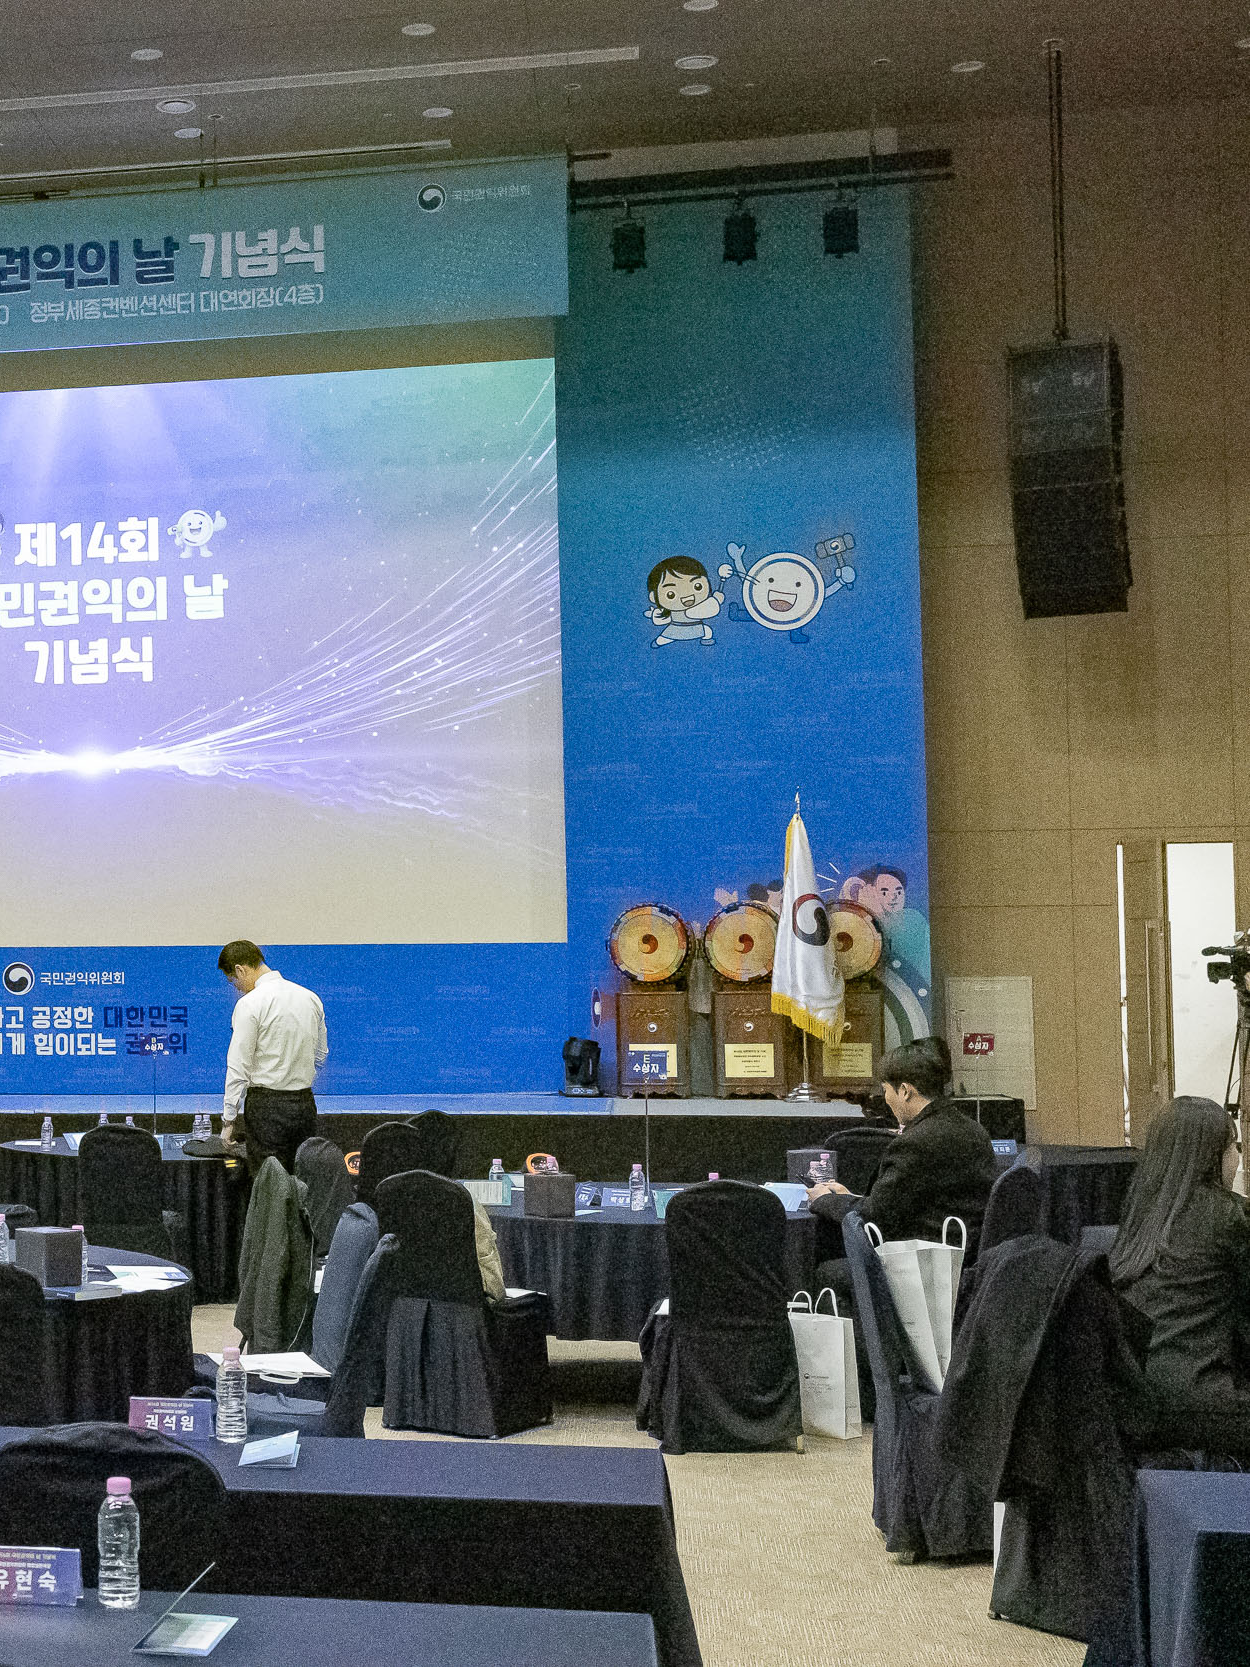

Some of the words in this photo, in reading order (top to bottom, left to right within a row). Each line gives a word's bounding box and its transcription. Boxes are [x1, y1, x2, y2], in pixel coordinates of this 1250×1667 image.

[132, 235, 180, 286] 날
[188, 224, 325, 279] 기념식
[200, 283, 324, 312] 대연회장(4층)
[14, 516, 159, 567] 제14회
[183, 573, 229, 620] 날
[24, 636, 153, 685] 기념식
[40, 971, 125, 986] 국민권익위원회
[32, 1006, 94, 1029] 공정한
[103, 1006, 189, 1029] 대한민국
[33, 1032, 117, 1056] 힘이되는
[968, 1041, 989, 1050] 수상자
[633, 1063, 659, 1073] 수상자
[643, 1054, 650, 1063] E
[145, 1414, 194, 1432] 권석원
